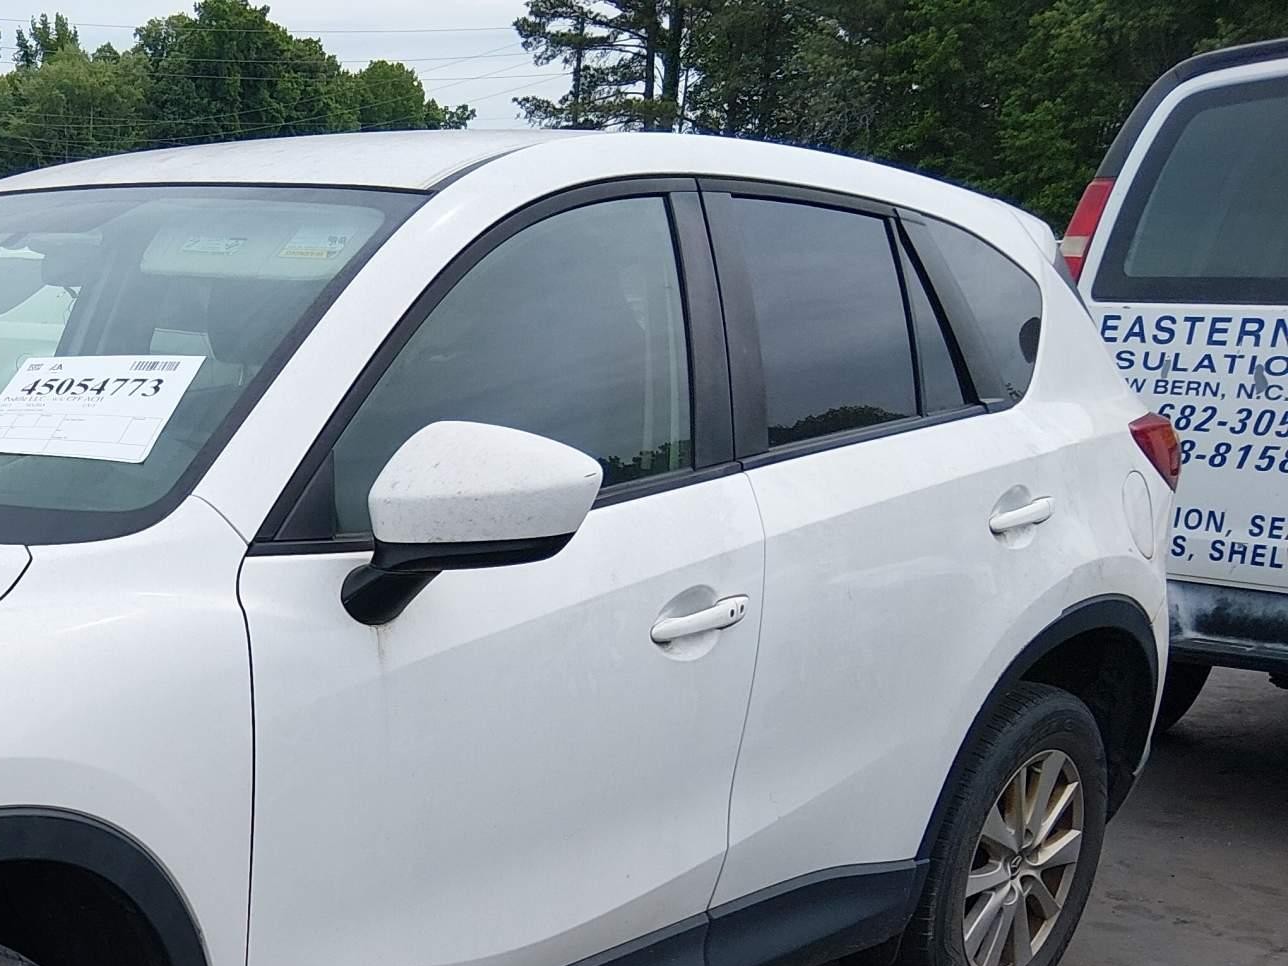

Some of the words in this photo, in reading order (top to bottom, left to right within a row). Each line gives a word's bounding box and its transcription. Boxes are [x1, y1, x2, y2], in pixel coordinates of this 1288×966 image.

[20, 377, 165, 397] 45054773
[1153, 378, 1226, 400] BERN,
[1173, 506, 1232, 538] ION,
[1248, 514, 1288, 540] SE
[1171, 535, 1194, 561] S,
